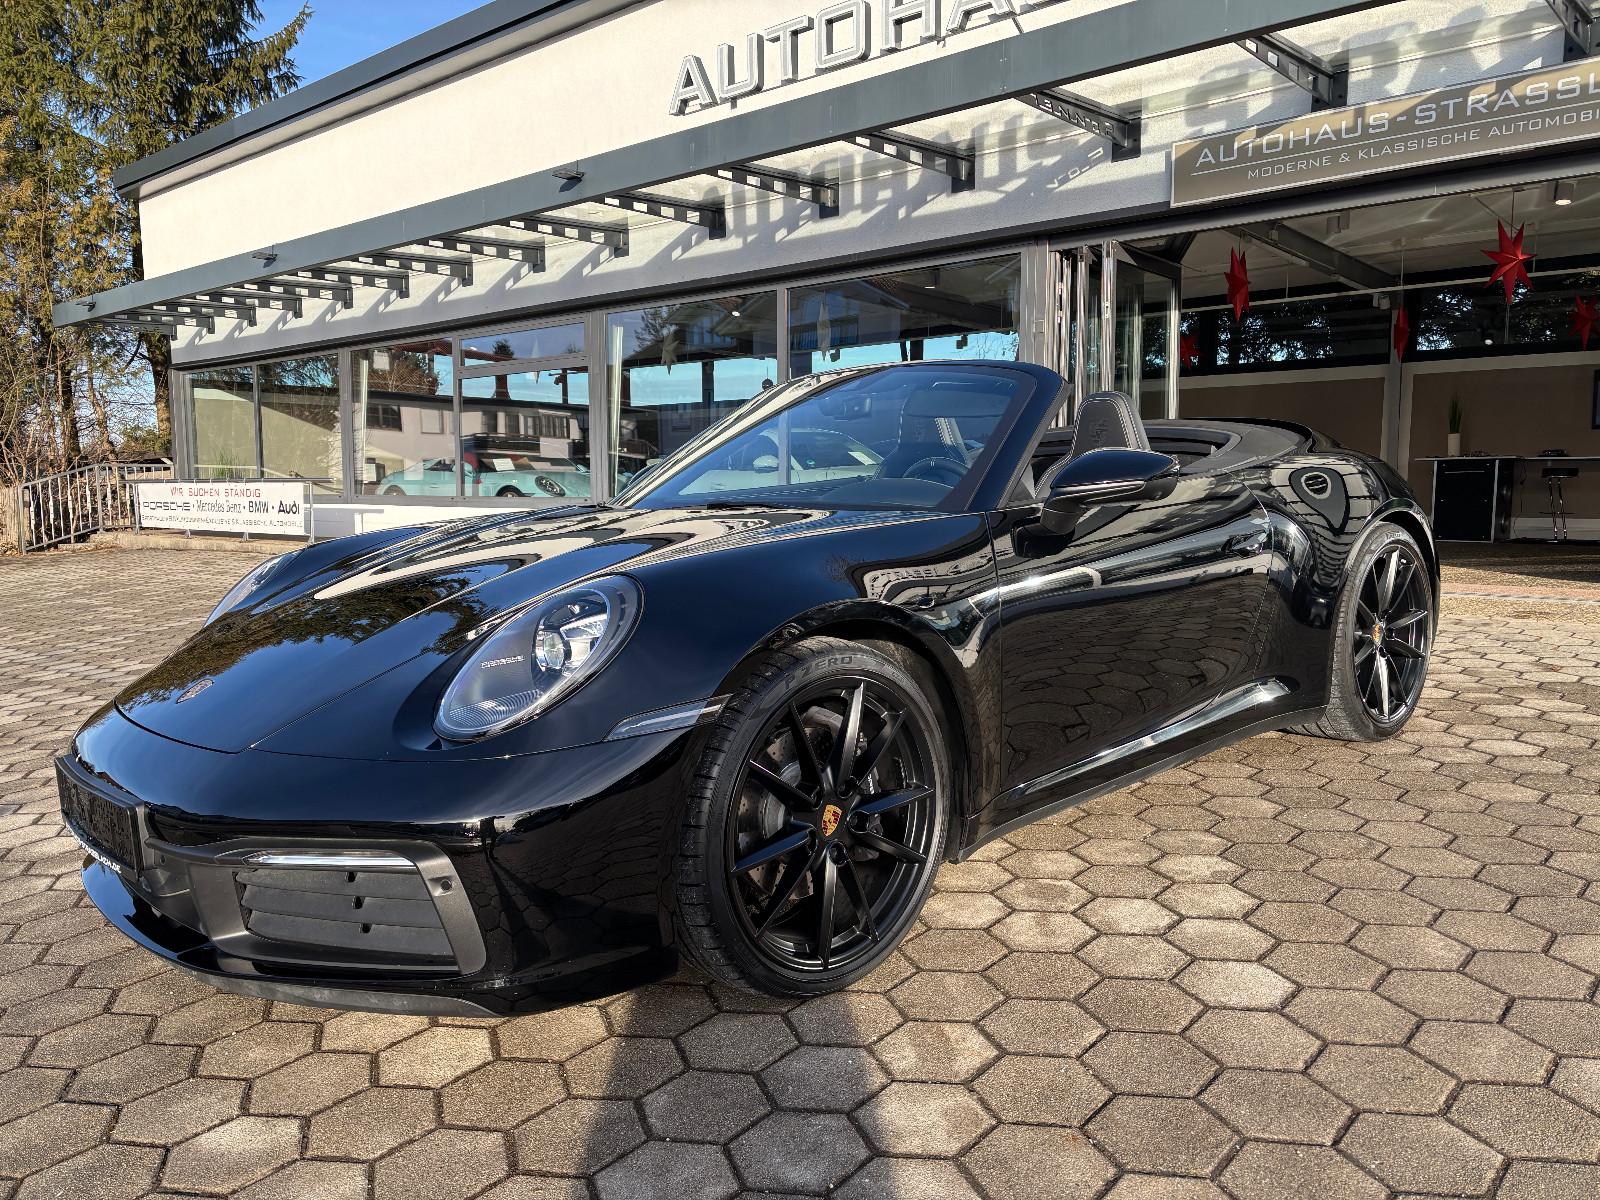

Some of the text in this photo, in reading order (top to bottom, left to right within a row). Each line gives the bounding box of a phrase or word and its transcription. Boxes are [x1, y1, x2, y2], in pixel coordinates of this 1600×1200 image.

[1195, 72, 1600, 168] AUTOHAUS-STRASSL
[1247, 108, 1600, 180] MODERNE & KLASSISCHE AUTOMOBI
[170, 486, 184, 497] WIR
[188, 487, 220, 497] SUCHEN
[143, 501, 191, 511] PORSCHE
[248, 500, 269, 514] BMW
[277, 500, 300, 515] Audi
[480, 654, 525, 669] PORSCHE
